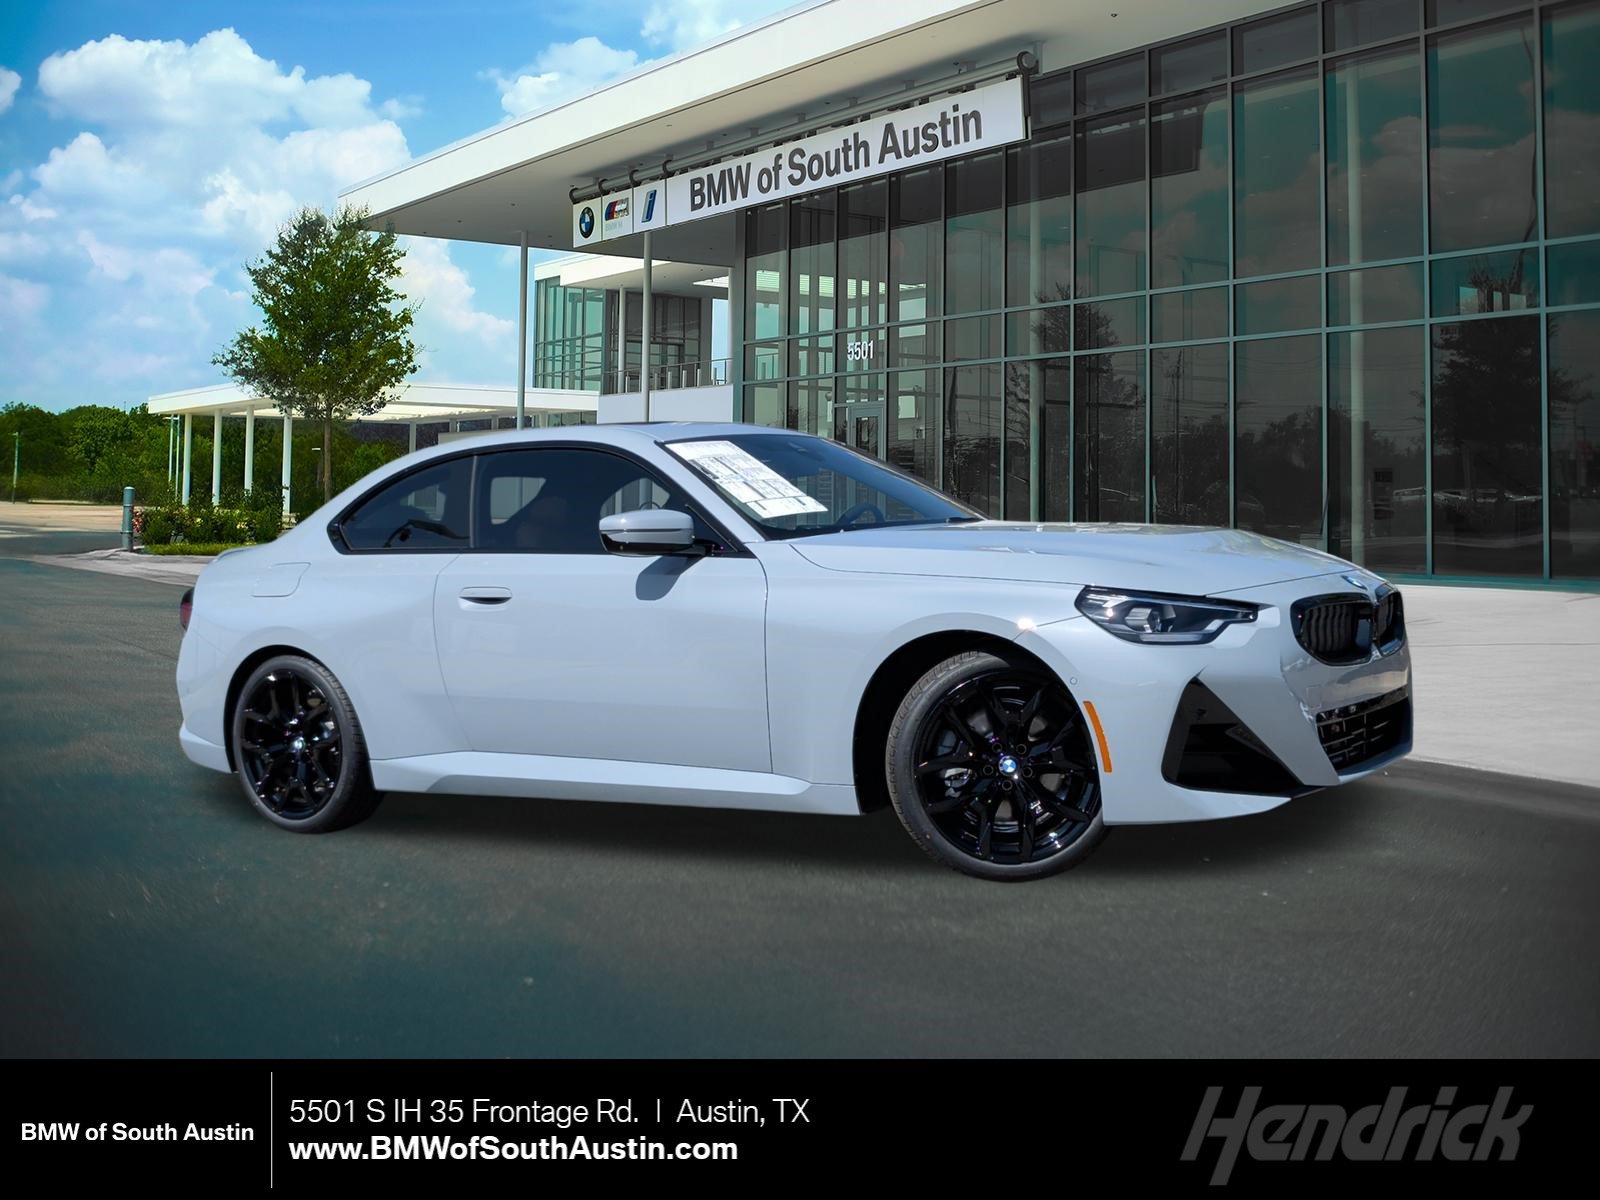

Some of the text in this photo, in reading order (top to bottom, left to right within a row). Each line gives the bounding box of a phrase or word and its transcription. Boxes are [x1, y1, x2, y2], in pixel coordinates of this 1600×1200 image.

[689, 105, 982, 212] BMW of South Austin
[847, 340, 874, 361] 5501
